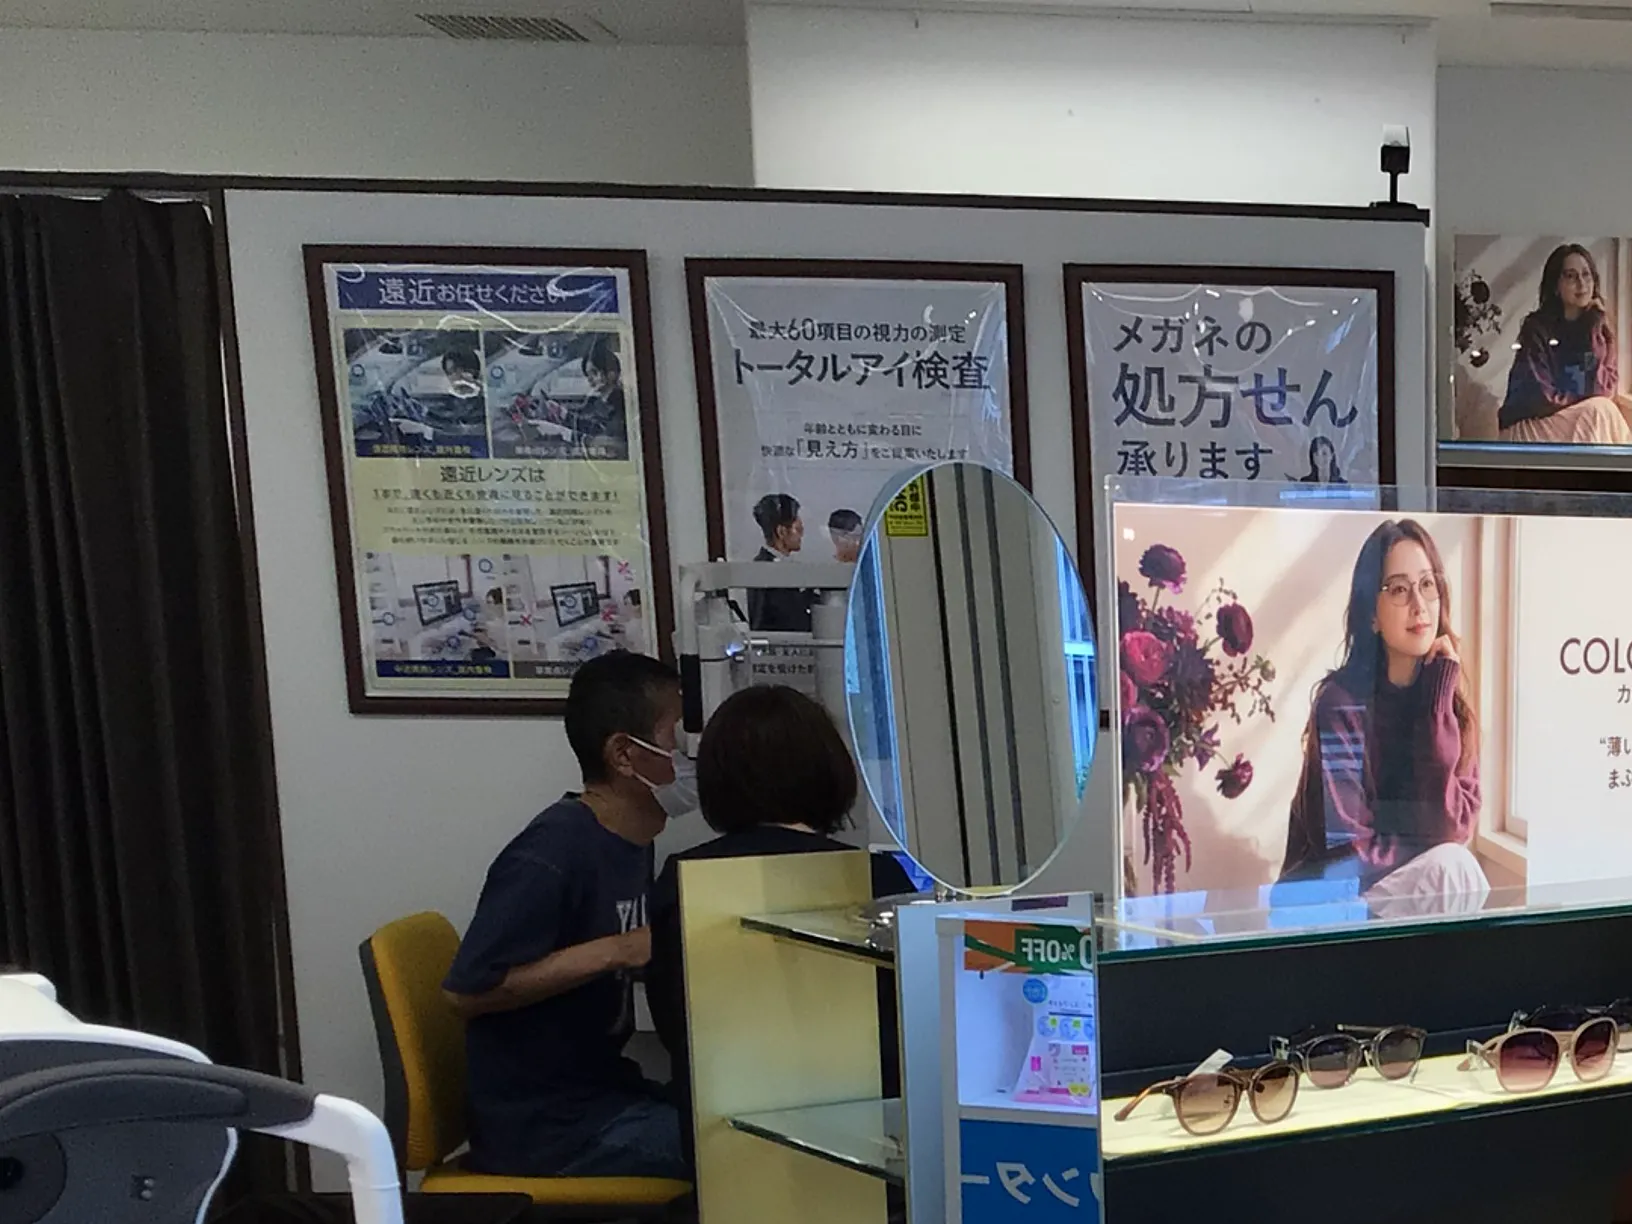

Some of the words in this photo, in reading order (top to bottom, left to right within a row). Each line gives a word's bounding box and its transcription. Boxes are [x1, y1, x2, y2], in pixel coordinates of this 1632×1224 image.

[378, 277, 567, 305] 遠近お任せください
[749, 317, 967, 344] 最大60項目の視力の測定
[1113, 315, 1272, 355] メガネの
[733, 348, 991, 390] トータルアイ検査
[1112, 362, 1358, 429] 処方せん
[440, 465, 547, 484] 遠近レンズは
[1117, 440, 1273, 481] 承ります
